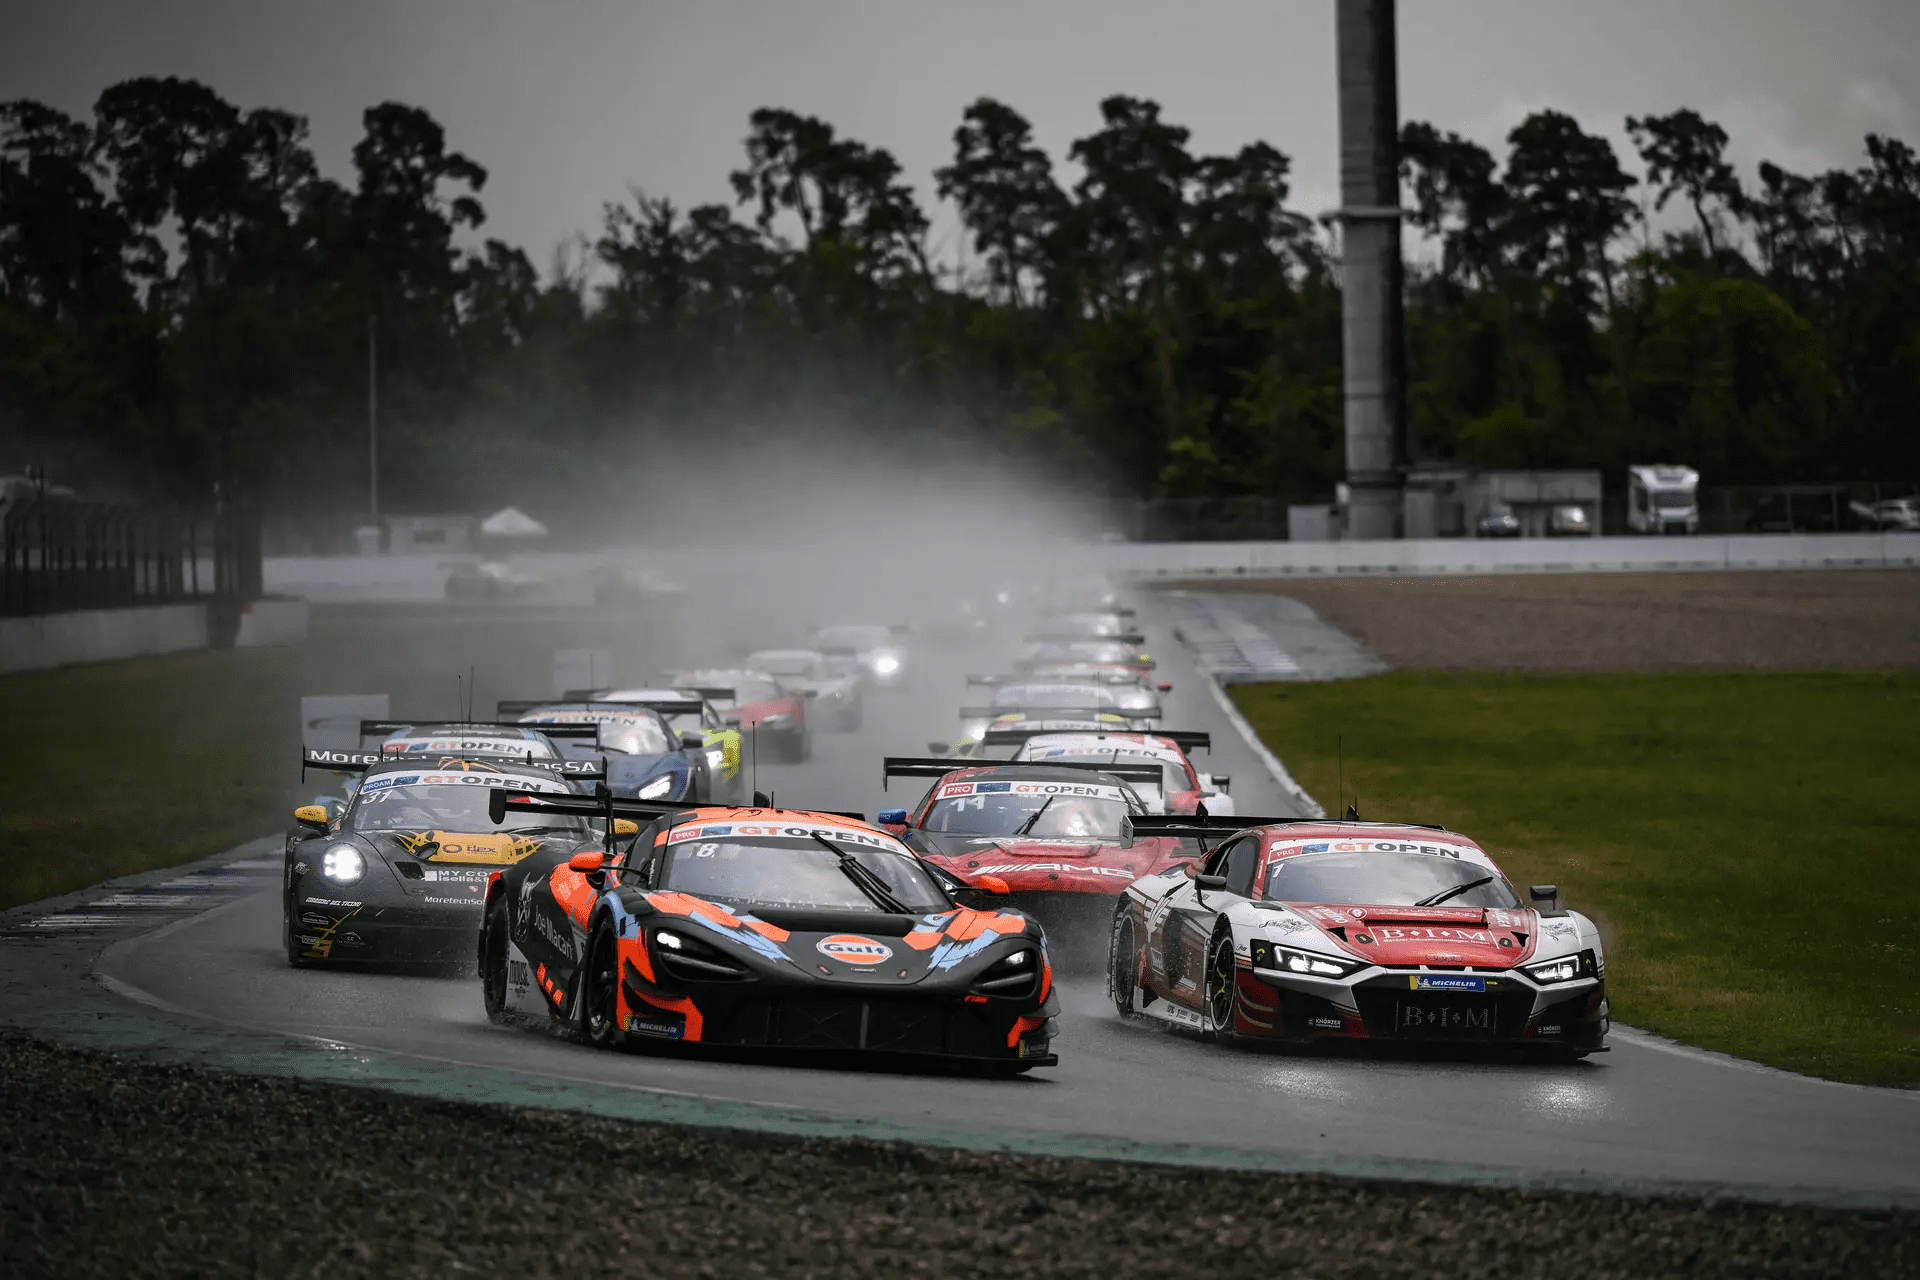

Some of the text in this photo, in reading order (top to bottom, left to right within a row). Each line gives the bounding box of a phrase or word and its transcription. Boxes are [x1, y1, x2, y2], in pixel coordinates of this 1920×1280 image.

[363, 779, 391, 791] PROAM
[946, 785, 971, 794] PRO
[361, 790, 393, 804] 31
[675, 830, 696, 839] PRO
[1276, 849, 1295, 857] PRO
[1025, 863, 1134, 879] AMG
[1272, 863, 1285, 878] 1
[424, 895, 485, 906] MoretechSo
[534, 904, 546, 936] Joe
[823, 943, 885, 955] Gulf
[640, 1022, 678, 1033] MICHELIN
